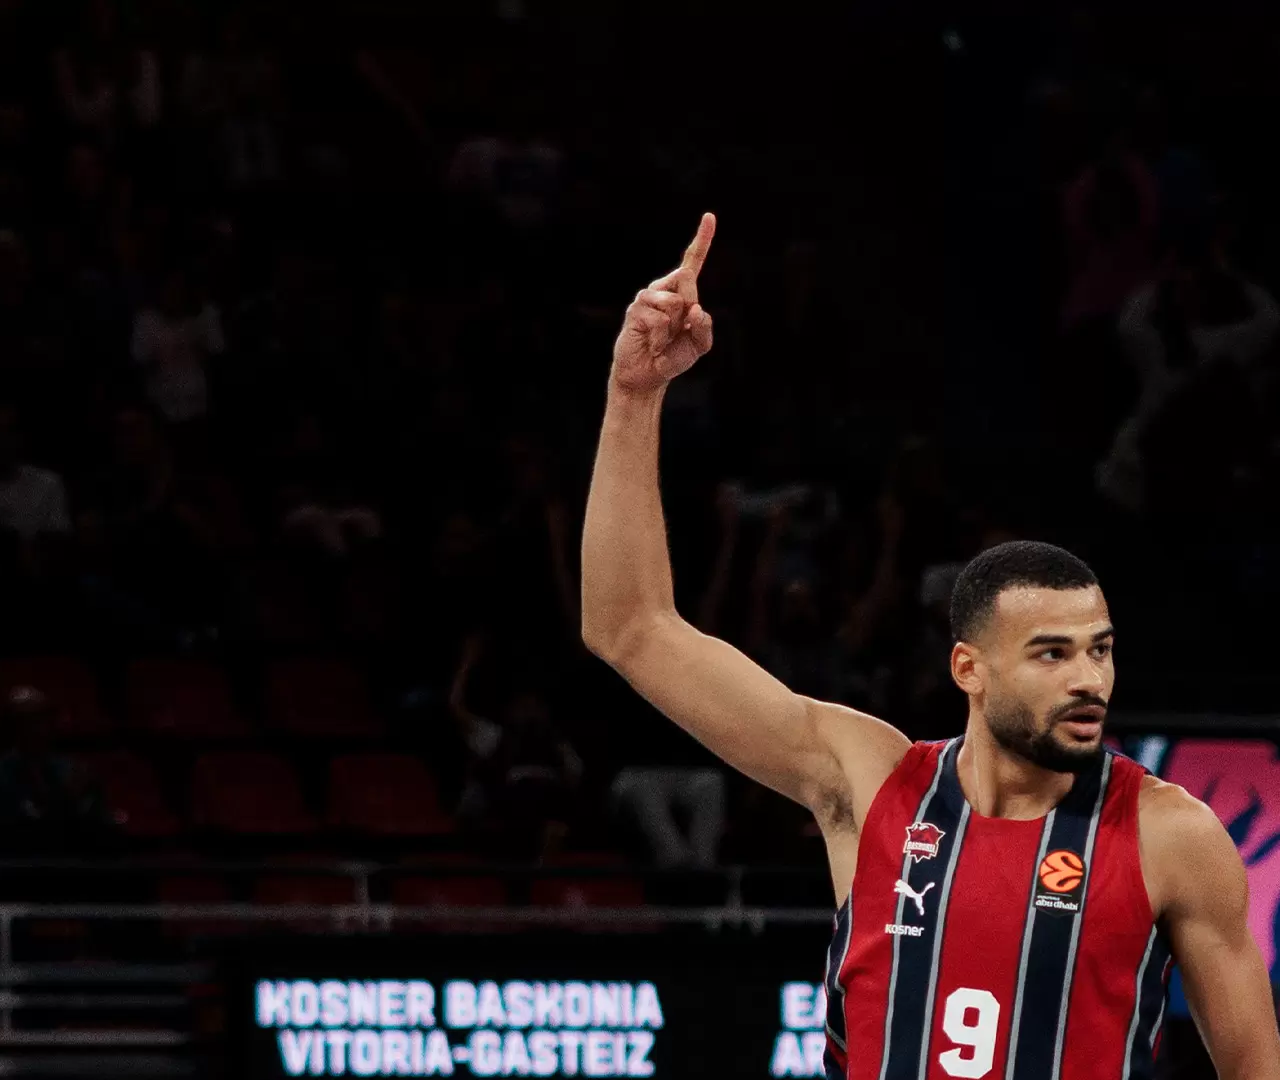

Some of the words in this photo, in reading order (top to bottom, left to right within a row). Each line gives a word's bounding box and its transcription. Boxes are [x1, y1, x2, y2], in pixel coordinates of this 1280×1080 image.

[256, 981, 435, 1028] KOSNER
[444, 982, 663, 1028] BASKONIA
[278, 1031, 655, 1076] VITORIA-GASTEIZ
[939, 988, 1000, 1080] 9
